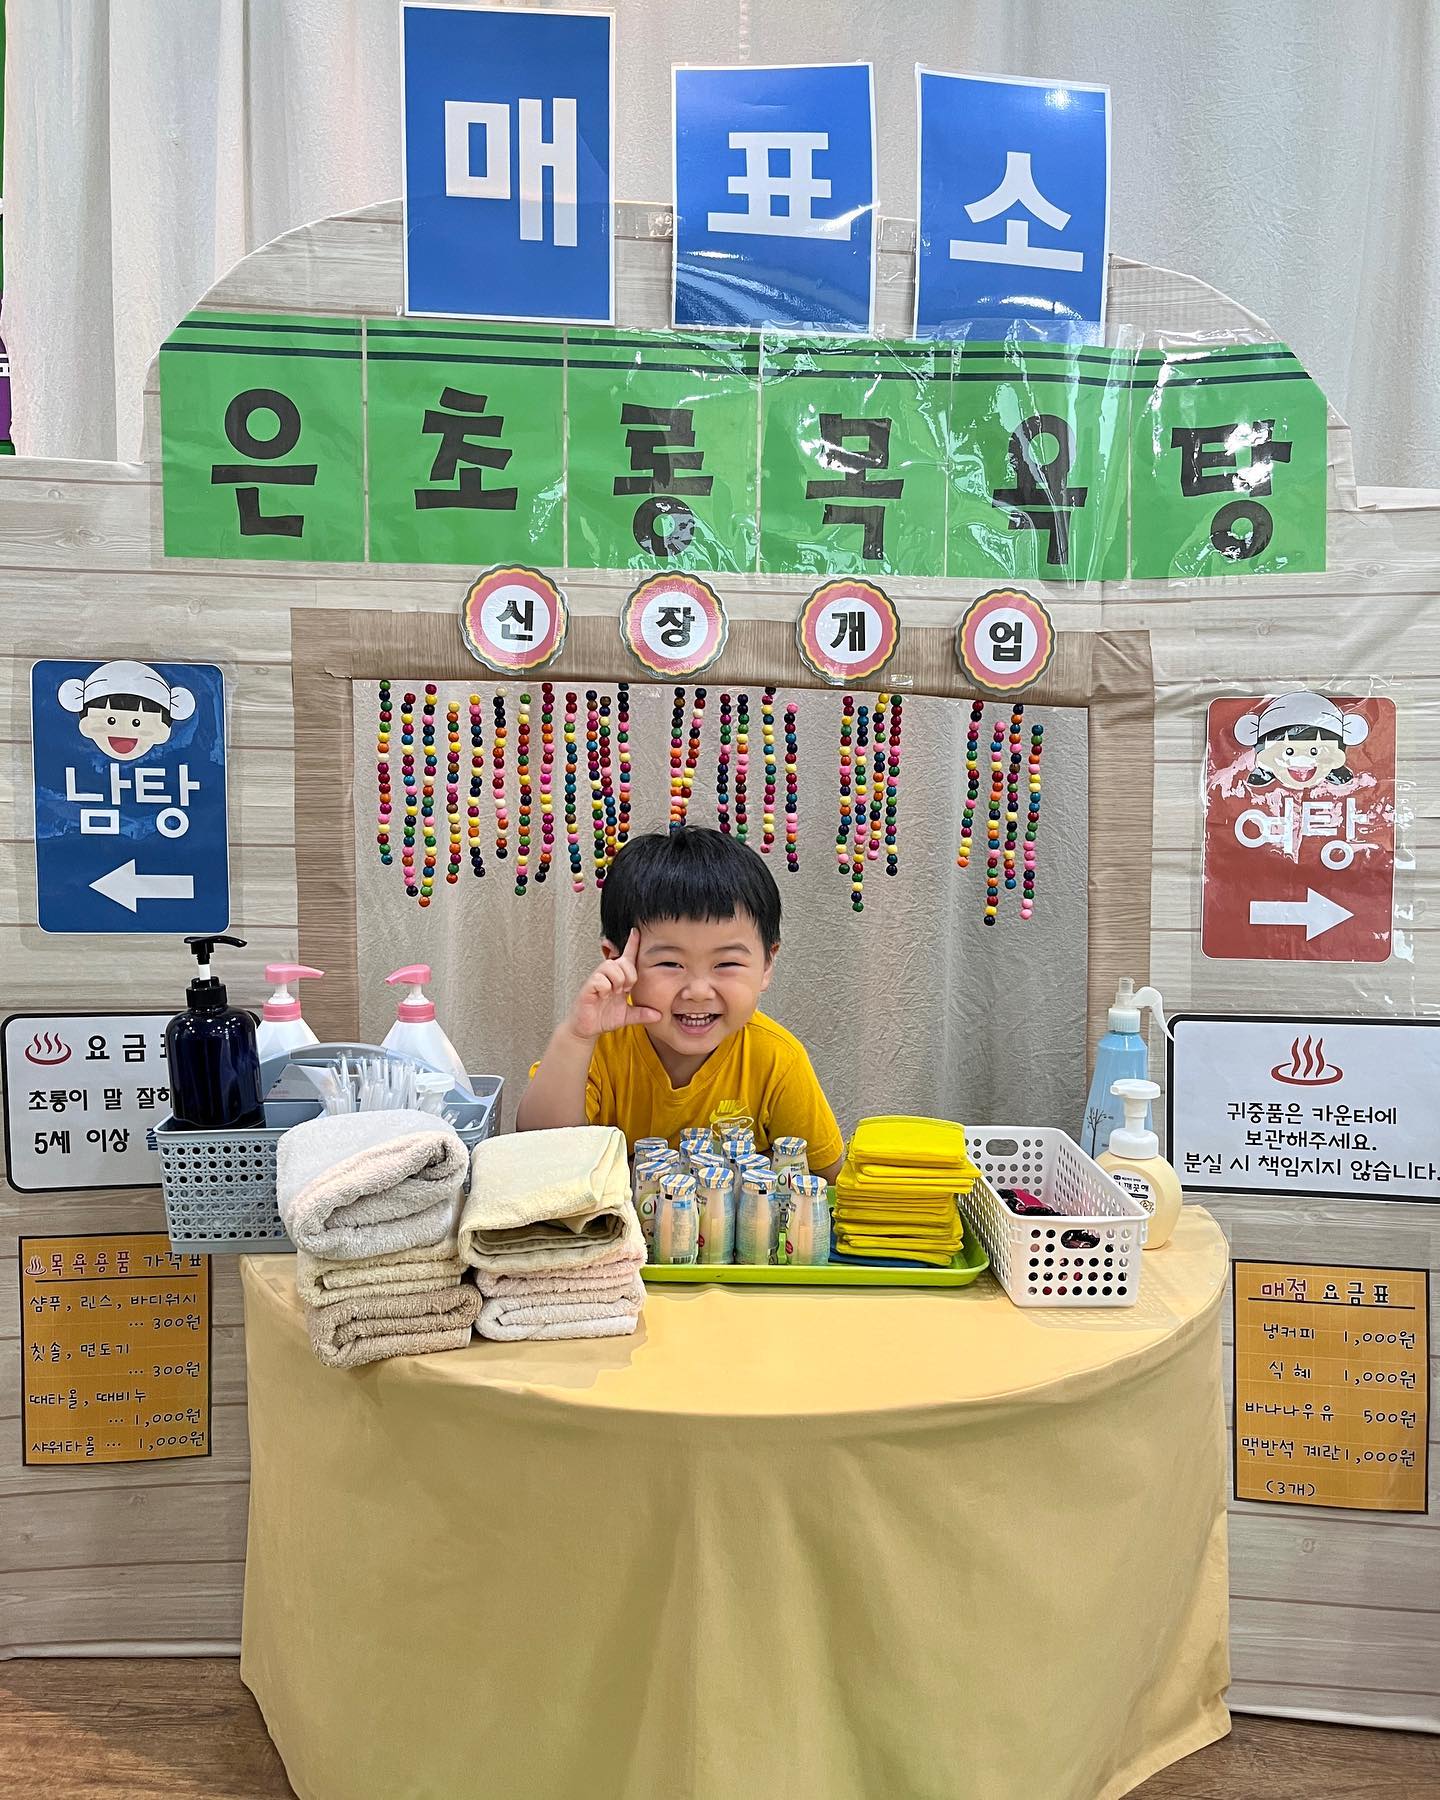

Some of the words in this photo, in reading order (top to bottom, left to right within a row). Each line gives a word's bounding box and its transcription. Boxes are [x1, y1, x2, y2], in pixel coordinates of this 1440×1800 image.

[444, 97, 1086, 273] 매표소
[495, 599, 1024, 663] 신장개업
[65, 762, 201, 839] 남탕
[1234, 797, 1370, 871] 여탕
[28, 1088, 88, 1113] 초롱이
[103, 1088, 123, 1110] 말
[1226, 1102, 1304, 1123] 귀중품은
[1311, 1104, 1398, 1127] 카운터에
[34, 1129, 71, 1155] 5세
[86, 1128, 130, 1153] 이상
[1244, 1129, 1378, 1152] 보관해주세요.
[1183, 1152, 1223, 1175] 분실
[1229, 1155, 1250, 1172] 시
[1257, 1154, 1342, 1178] 책임지지
[1350, 1158, 1440, 1182] 않습니다.
[50, 1250, 130, 1276] 목욕용품
[143, 1251, 202, 1271] 가격표
[29, 1294, 72, 1313] 샴푸,
[80, 1293, 122, 1310] 린스,
[129, 1293, 197, 1306] 바디워시
[1261, 1278, 1307, 1302] 매점
[1322, 1282, 1390, 1306] 요금표
[152, 1313, 201, 1331] 300원
[1263, 1322, 1315, 1340] 냉커피
[1343, 1330, 1415, 1350] 1,000원
[29, 1340, 73, 1363] 칫솔,
[80, 1342, 130, 1358] 면도기
[152, 1361, 201, 1378] 300원
[1343, 1370, 1416, 1390] 1,000원
[29, 1388, 89, 1411] 때타올,
[95, 1388, 147, 1404] 때비누
[135, 1408, 201, 1429] 1,000원
[1245, 1402, 1335, 1422] 바나나우유
[1363, 1410, 1416, 1429] 500원
[32, 1435, 96, 1457] 샤워타올
[139, 1431, 205, 1451] 1,000원
[1241, 1437, 1295, 1459] 맥반석
[1302, 1444, 1342, 1461] 계란
[1344, 1449, 1415, 1468] 1,000원
[1265, 1480, 1316, 1497] (3개)
